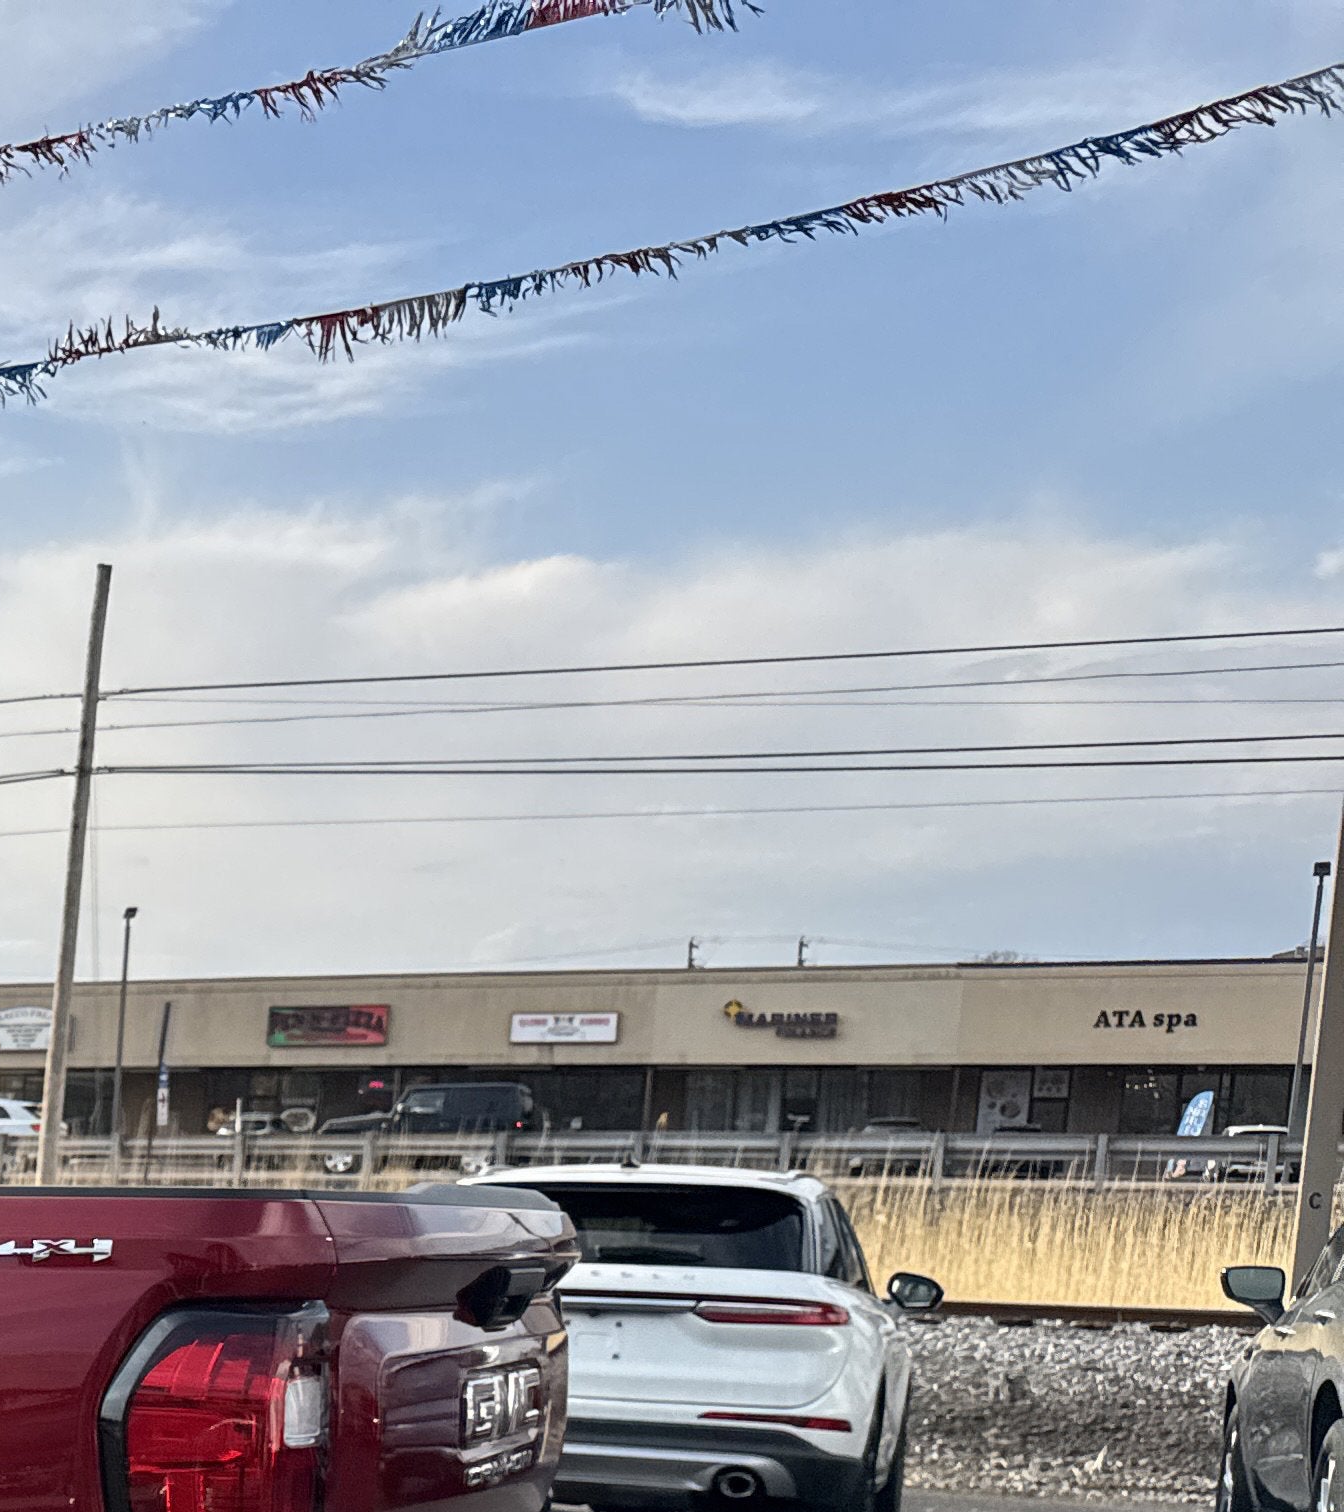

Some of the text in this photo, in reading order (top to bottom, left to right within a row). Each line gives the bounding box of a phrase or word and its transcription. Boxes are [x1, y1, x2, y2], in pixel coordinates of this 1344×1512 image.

[1093, 1010, 1198, 1034] ATA spa
[464, 1367, 541, 1446] GMC
